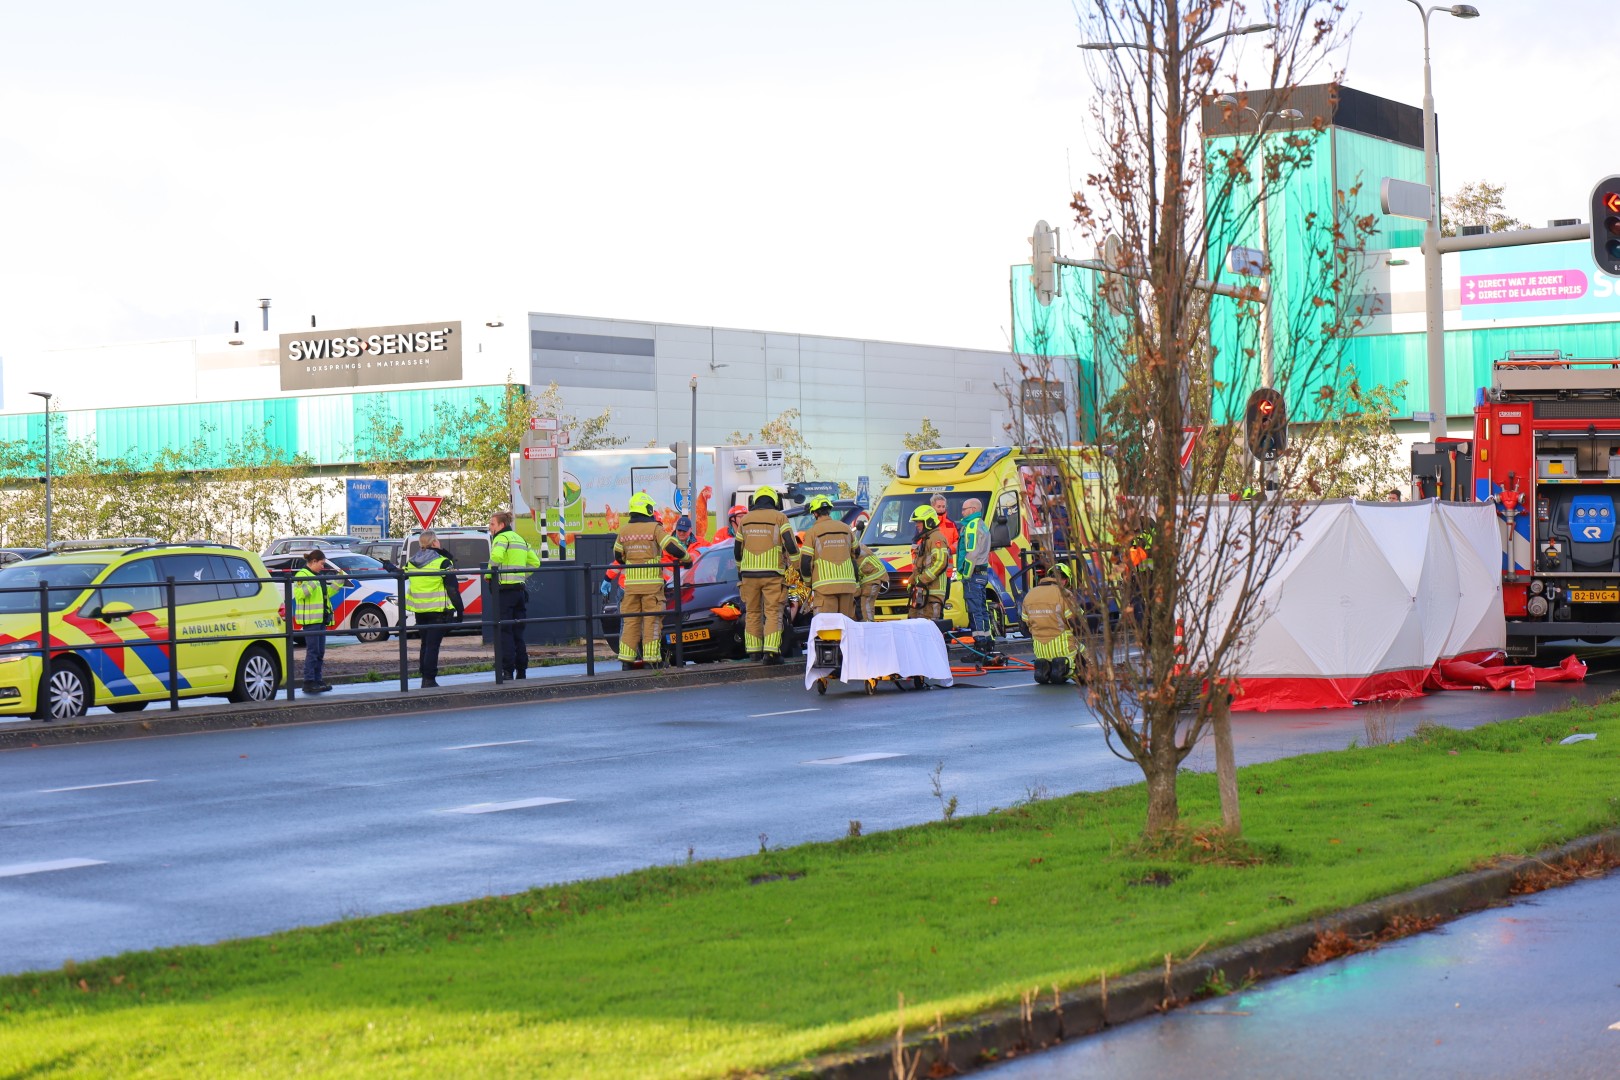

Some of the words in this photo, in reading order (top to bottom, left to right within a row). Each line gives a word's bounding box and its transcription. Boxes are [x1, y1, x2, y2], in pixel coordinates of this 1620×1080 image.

[1478, 278, 1506, 289] DIRECT
[1508, 277, 1527, 287] WAT
[1528, 276, 1537, 286] JE
[1538, 275, 1563, 285] ZOEKT
[1478, 289, 1506, 300] DIRECT
[1508, 288, 1519, 298] DE
[1520, 286, 1557, 297] LAAGSTE
[1558, 285, 1582, 295] PRIJS
[306, 362, 362, 373] BOXSPRINGS
[367, 360, 372, 368] &
[376, 358, 431, 371] MATRASSEN
[359, 492, 387, 501] richtingen
[351, 525, 374, 533] Centrum
[1574, 591, 1616, 601] 82-BVG-4
[182, 622, 237, 635] AMBULANCE
